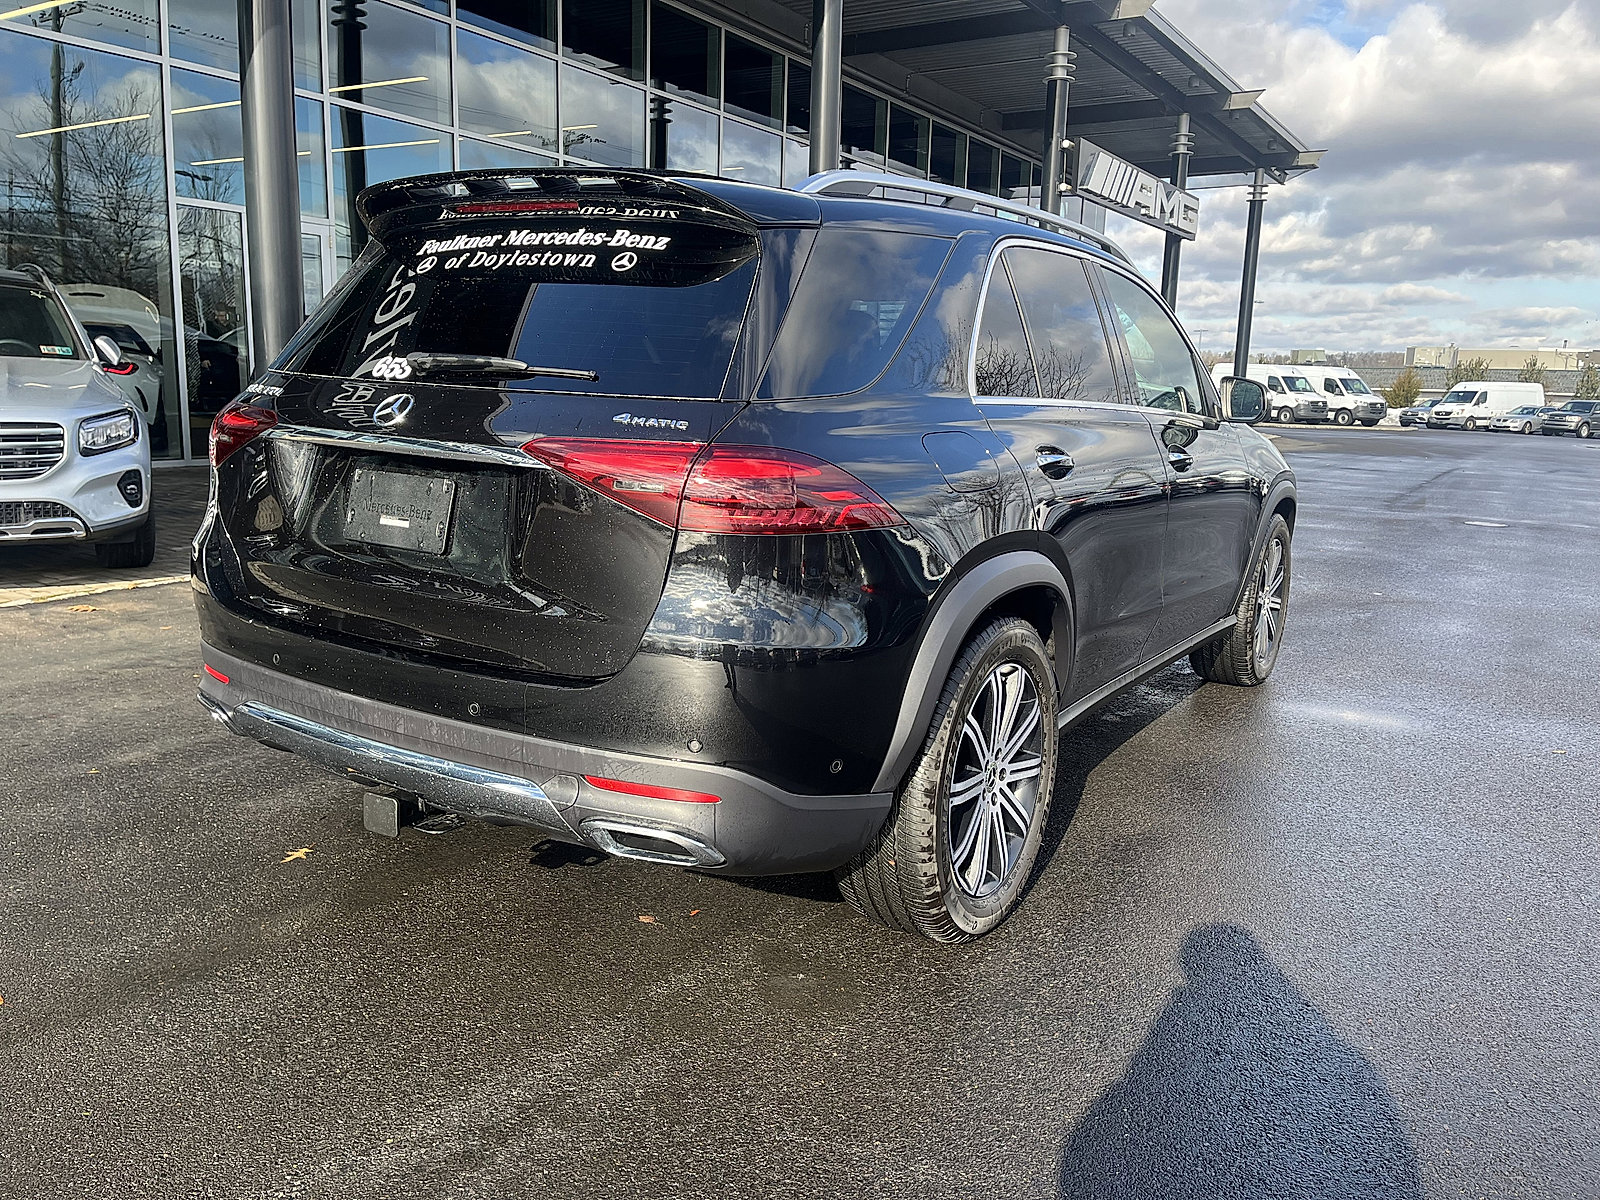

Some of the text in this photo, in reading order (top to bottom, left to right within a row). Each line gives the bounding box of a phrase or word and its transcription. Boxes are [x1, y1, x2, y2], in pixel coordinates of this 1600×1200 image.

[416, 227, 671, 256] Faulkner Mercedes-Benz
[444, 250, 597, 270] of Doylestown
[612, 413, 689, 430] 4MATIC
